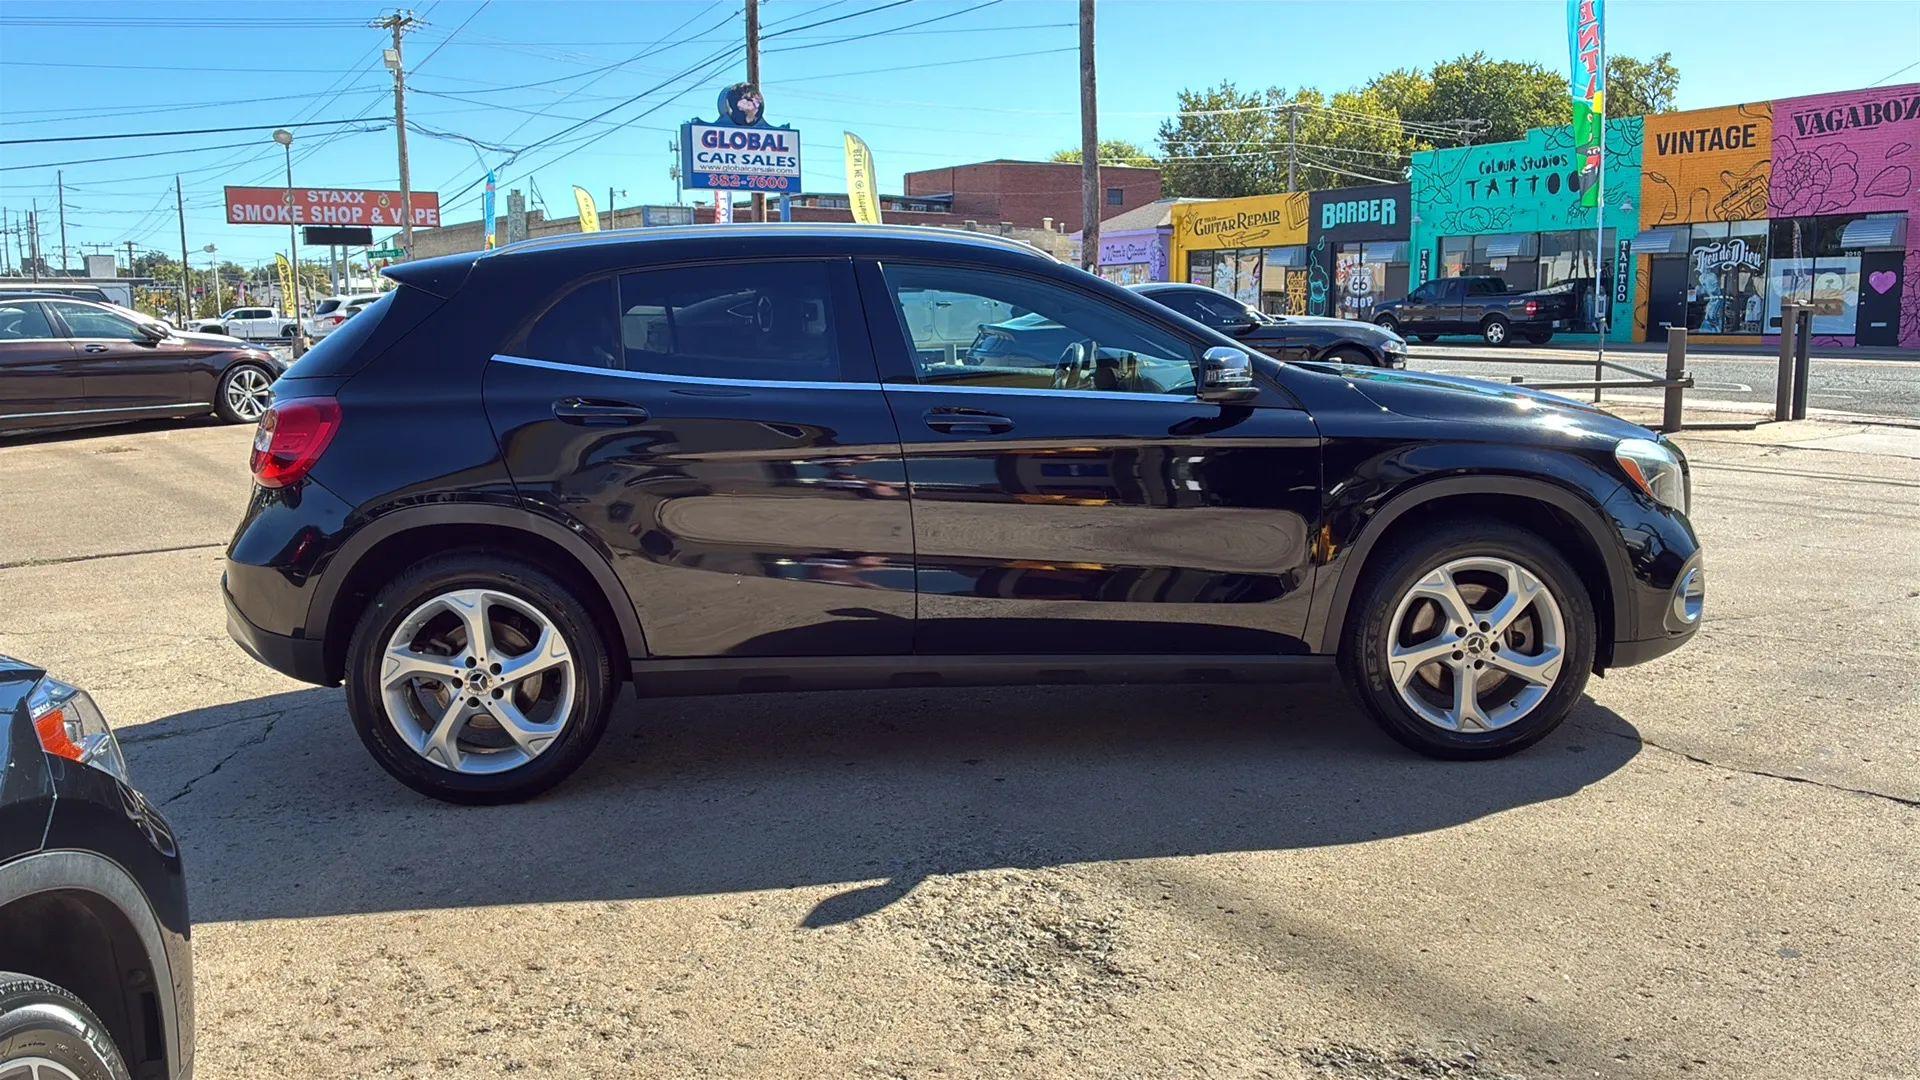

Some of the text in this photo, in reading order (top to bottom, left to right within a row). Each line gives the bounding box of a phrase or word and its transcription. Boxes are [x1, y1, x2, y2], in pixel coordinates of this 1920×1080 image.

[701, 129, 789, 152] GLOBAL
[1656, 123, 1757, 156] VINTAGE
[697, 152, 796, 168] CAR SALES
[708, 174, 788, 189] 382-7600
[1465, 170, 1581, 200] TATTOO
[306, 190, 365, 204] STAXX
[232, 203, 303, 222] SMOKE
[310, 206, 363, 223] SHOP
[370, 208, 384, 224] &
[1193, 209, 1281, 236] GUITAR REPAIR
[1321, 198, 1397, 229] BARBER
[1617, 240, 1629, 301] TATTOO
[1352, 276, 1368, 291] 66
[1345, 295, 1374, 307] SHOP
